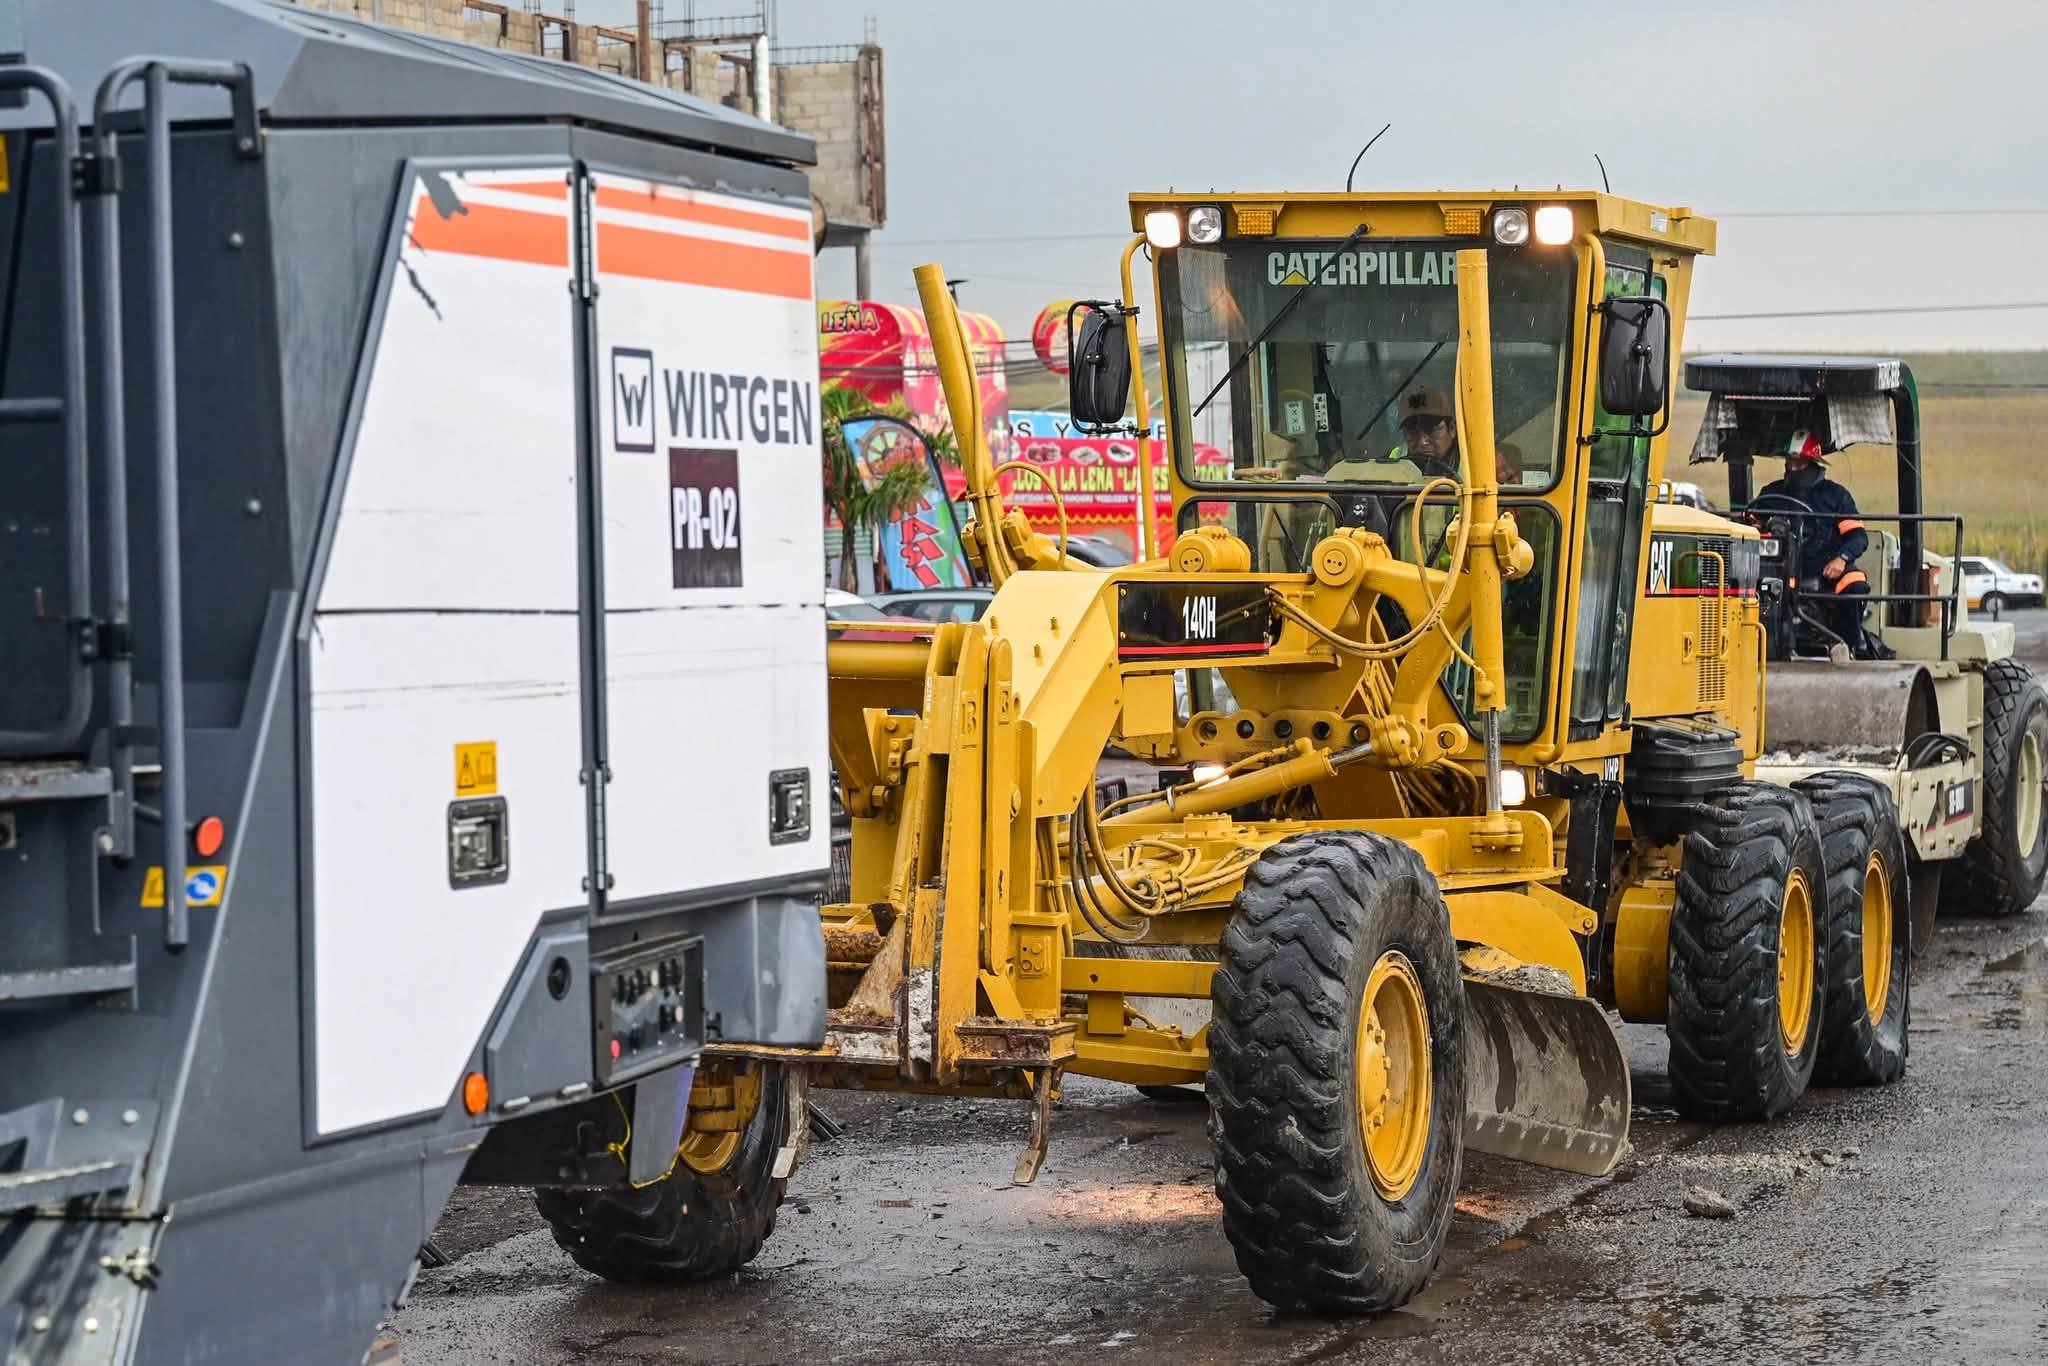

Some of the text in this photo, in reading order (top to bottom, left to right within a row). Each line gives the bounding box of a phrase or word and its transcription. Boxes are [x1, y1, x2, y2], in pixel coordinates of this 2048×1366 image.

[1267, 251, 1458, 286] CATERPILLAR
[821, 304, 879, 333] LEÑA
[664, 369, 813, 445] WIRTGEN
[1061, 466, 1077, 491] LA
[1081, 458, 1115, 491] LEÑA
[672, 486, 739, 550] PR-02
[1650, 540, 1673, 594] CAT
[1183, 595, 1216, 640] 140H
